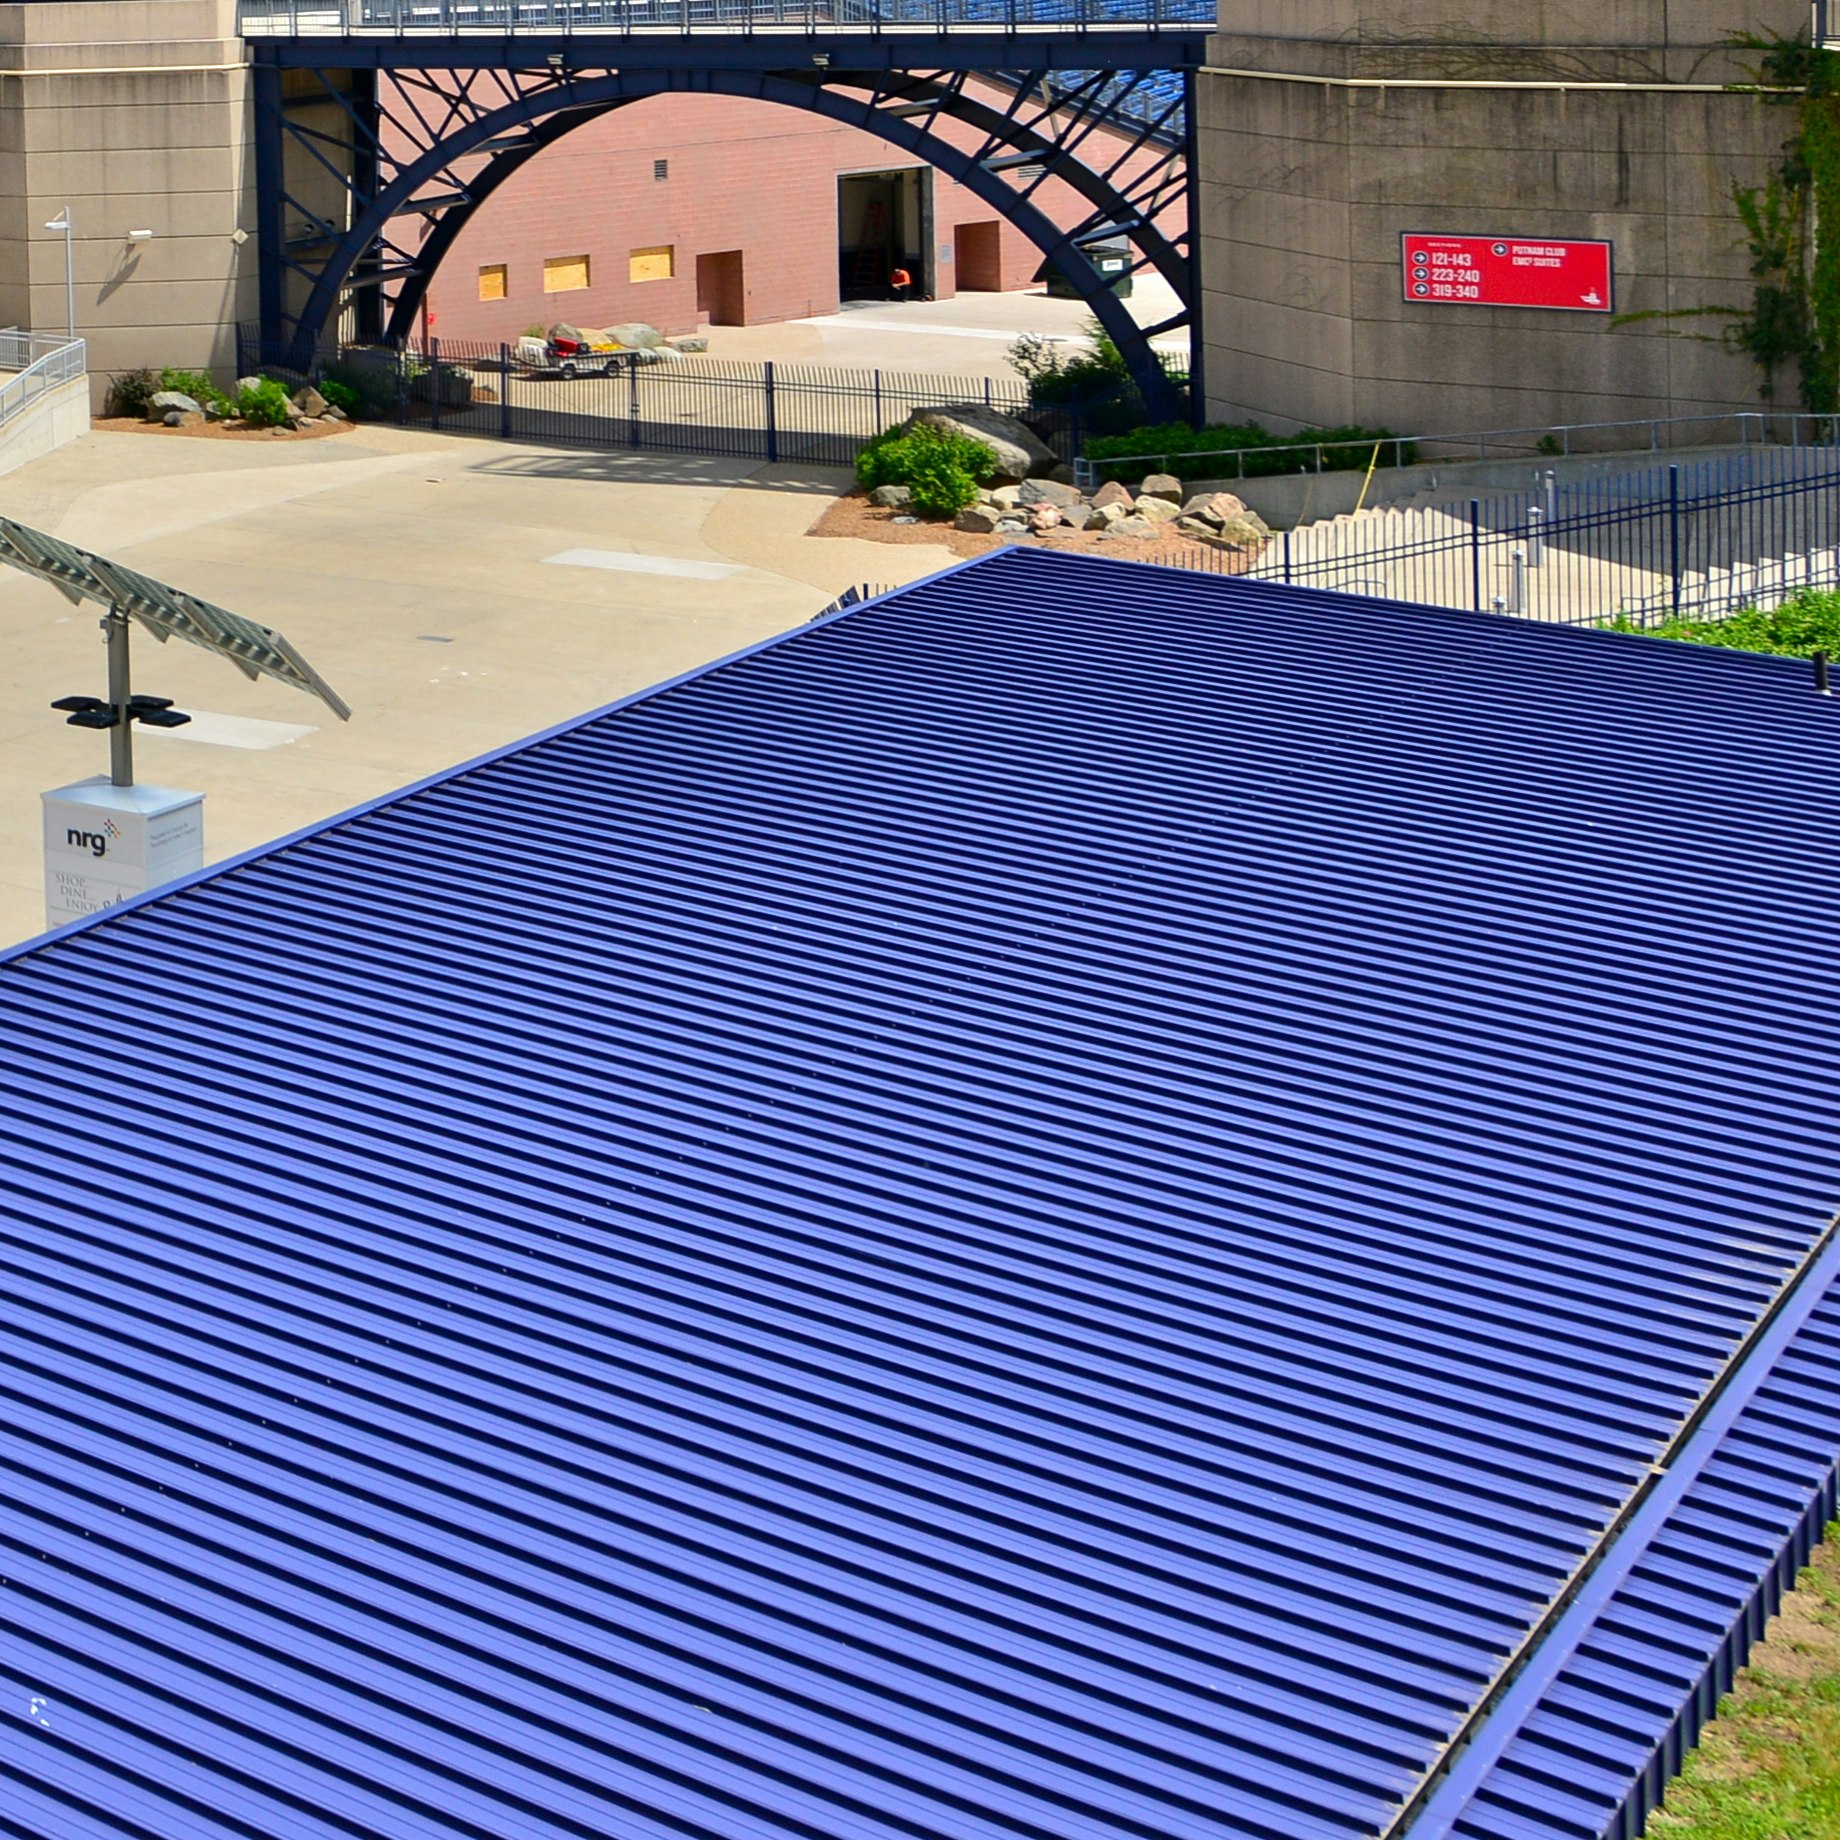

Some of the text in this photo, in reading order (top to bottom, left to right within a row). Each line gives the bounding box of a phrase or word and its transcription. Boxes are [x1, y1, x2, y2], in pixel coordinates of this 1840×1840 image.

[1432, 252, 1471, 266] 121-143
[1431, 268, 1480, 283] 223-240
[1432, 283, 1479, 298] 319-340
[67, 828, 106, 857] nrg
